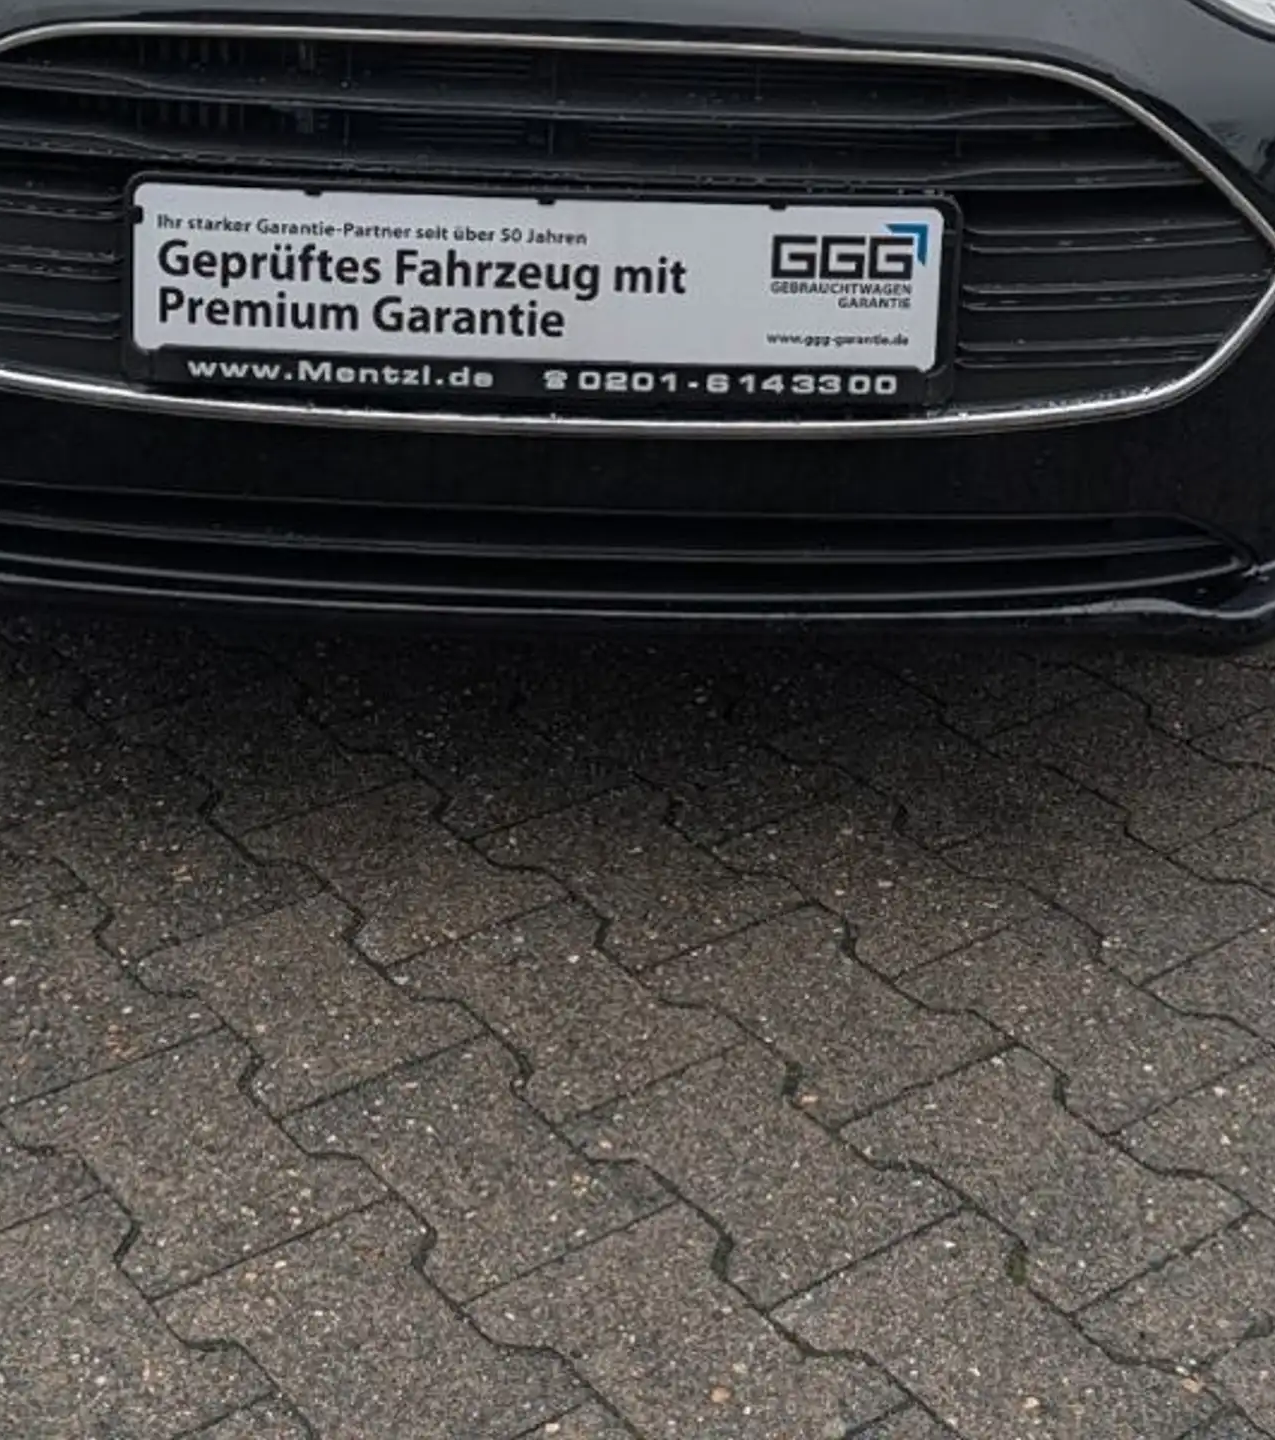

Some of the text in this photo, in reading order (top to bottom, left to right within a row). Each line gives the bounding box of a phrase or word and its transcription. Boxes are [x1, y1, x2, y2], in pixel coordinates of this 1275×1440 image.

[157, 213, 587, 246] Ihr starker Garantie-Partner seit über 50 Jahren
[158, 238, 688, 302] Geprüftes Fahrzeug mit
[770, 235, 914, 280] GGG
[770, 281, 913, 295] GEBRAUCHTWAGEN
[837, 297, 912, 309] GARANTIE
[158, 287, 566, 337] Premium Garantie
[186, 359, 494, 389] www.Mentzl.de
